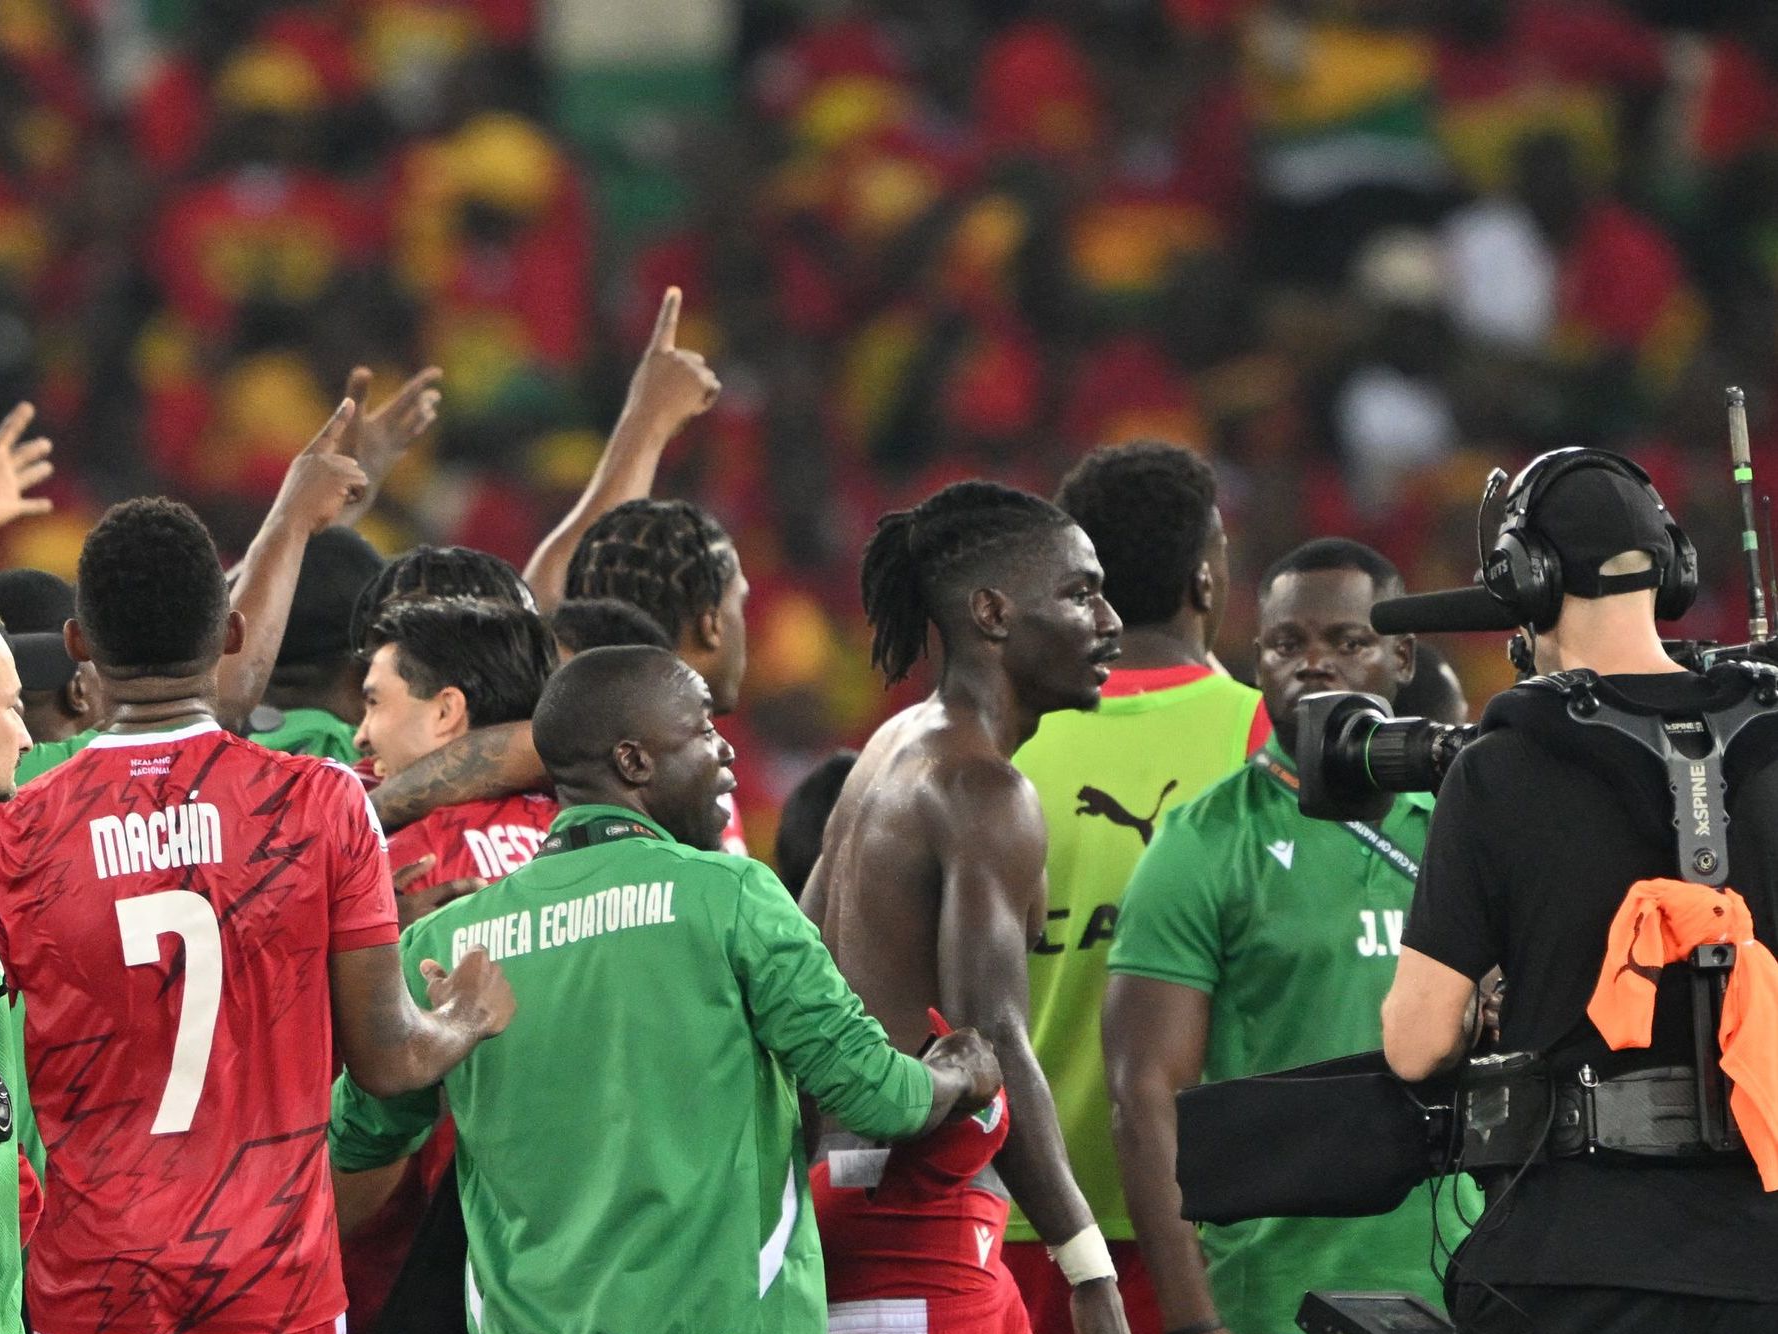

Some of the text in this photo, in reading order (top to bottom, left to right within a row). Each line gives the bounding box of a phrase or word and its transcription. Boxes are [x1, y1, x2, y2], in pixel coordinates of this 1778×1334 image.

[130, 767, 171, 777] NACIONAL
[89, 790, 223, 880] MACHÍN
[452, 881, 676, 970] GUINEA ECUATORIAL
[114, 890, 223, 1135] 7
